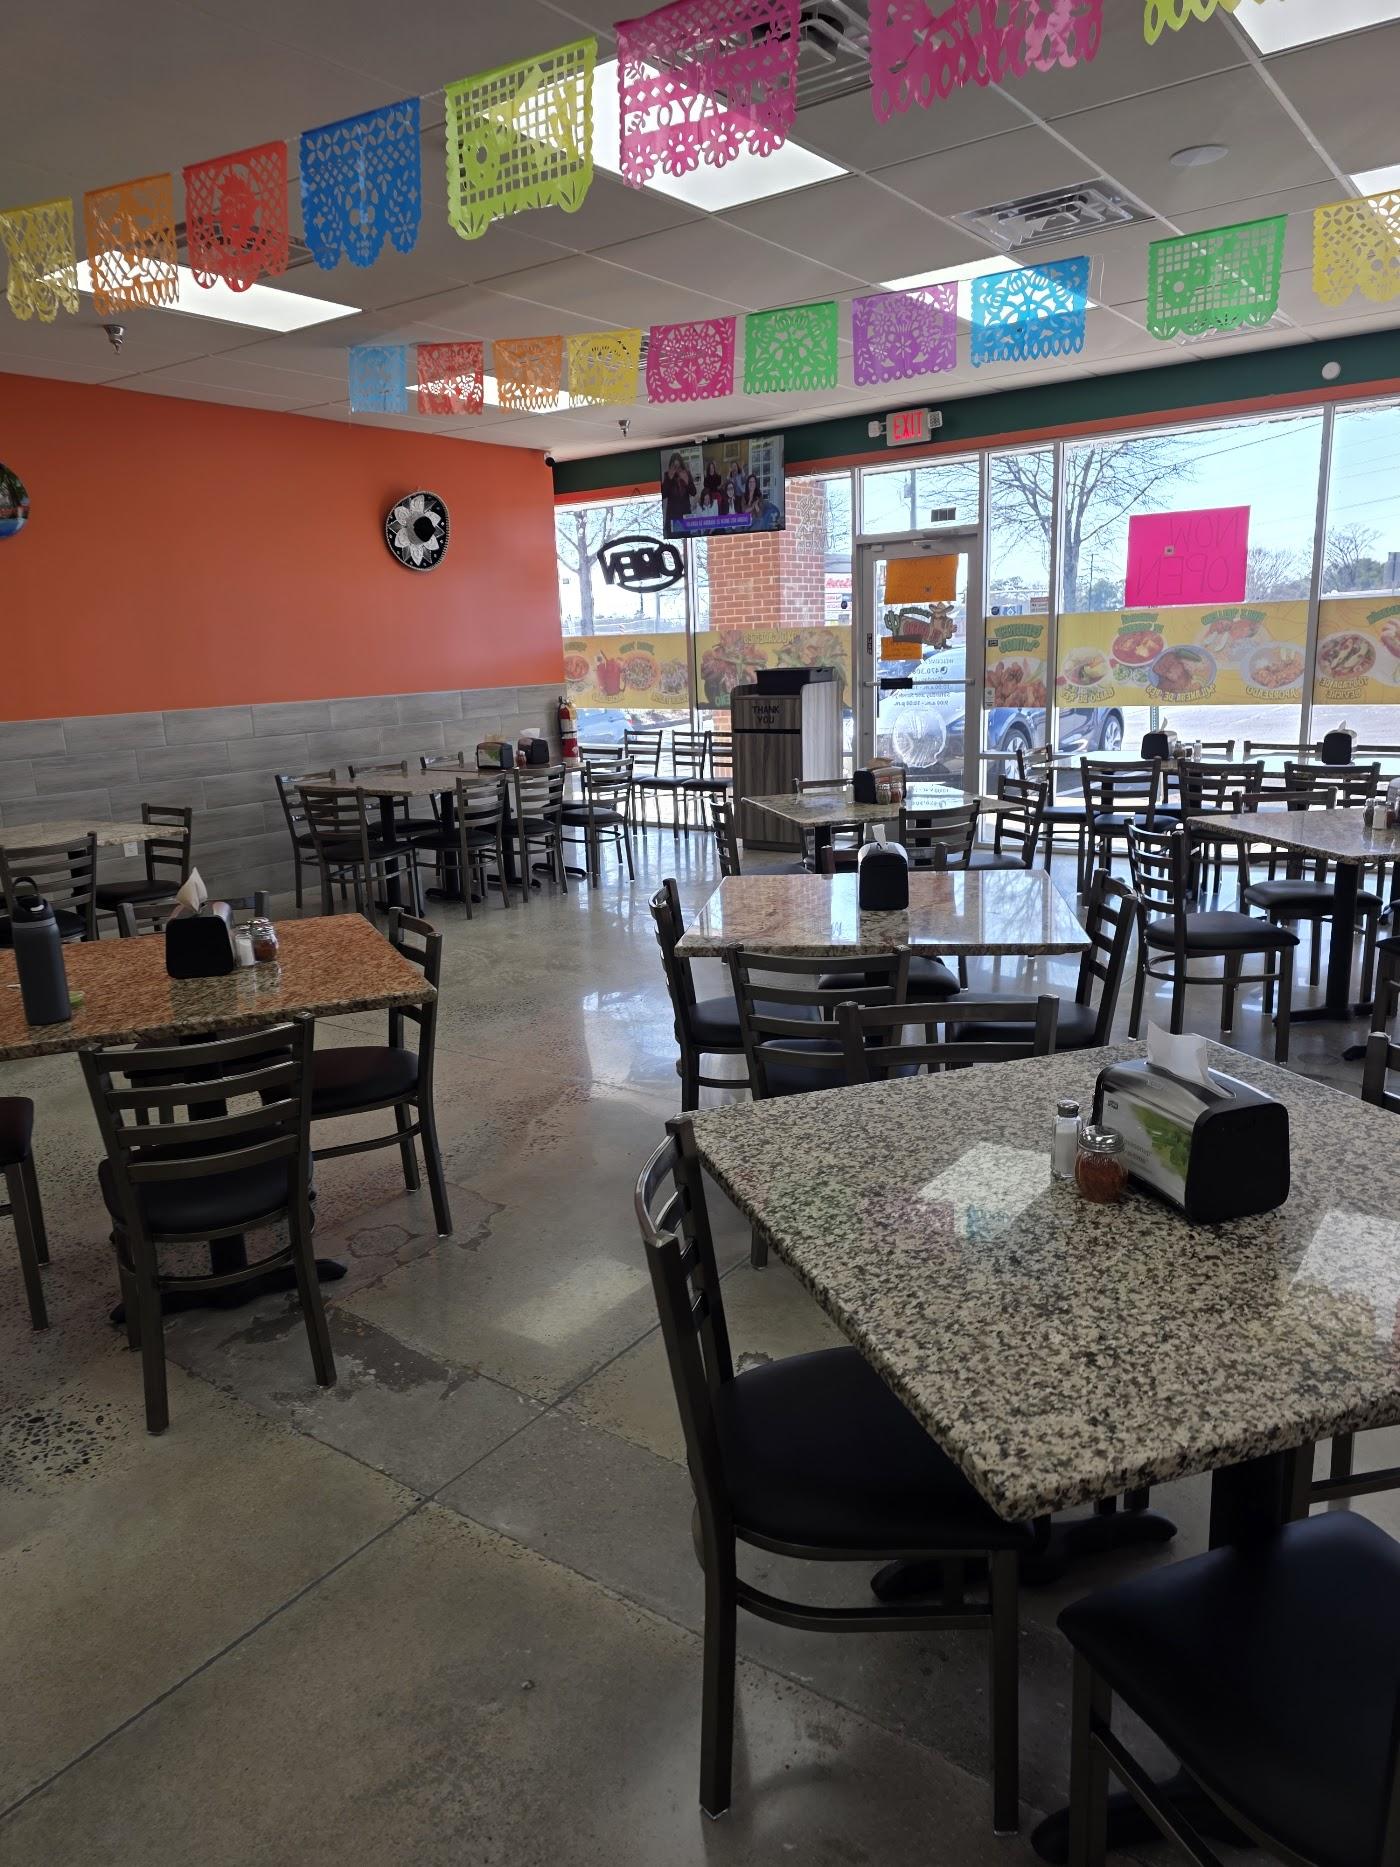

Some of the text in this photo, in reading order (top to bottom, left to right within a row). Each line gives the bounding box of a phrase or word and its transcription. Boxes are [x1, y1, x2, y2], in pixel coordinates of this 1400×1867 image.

[894, 411, 924, 440] EXIT
[752, 705, 780, 715] THANK
[758, 715, 775, 724] YOU
